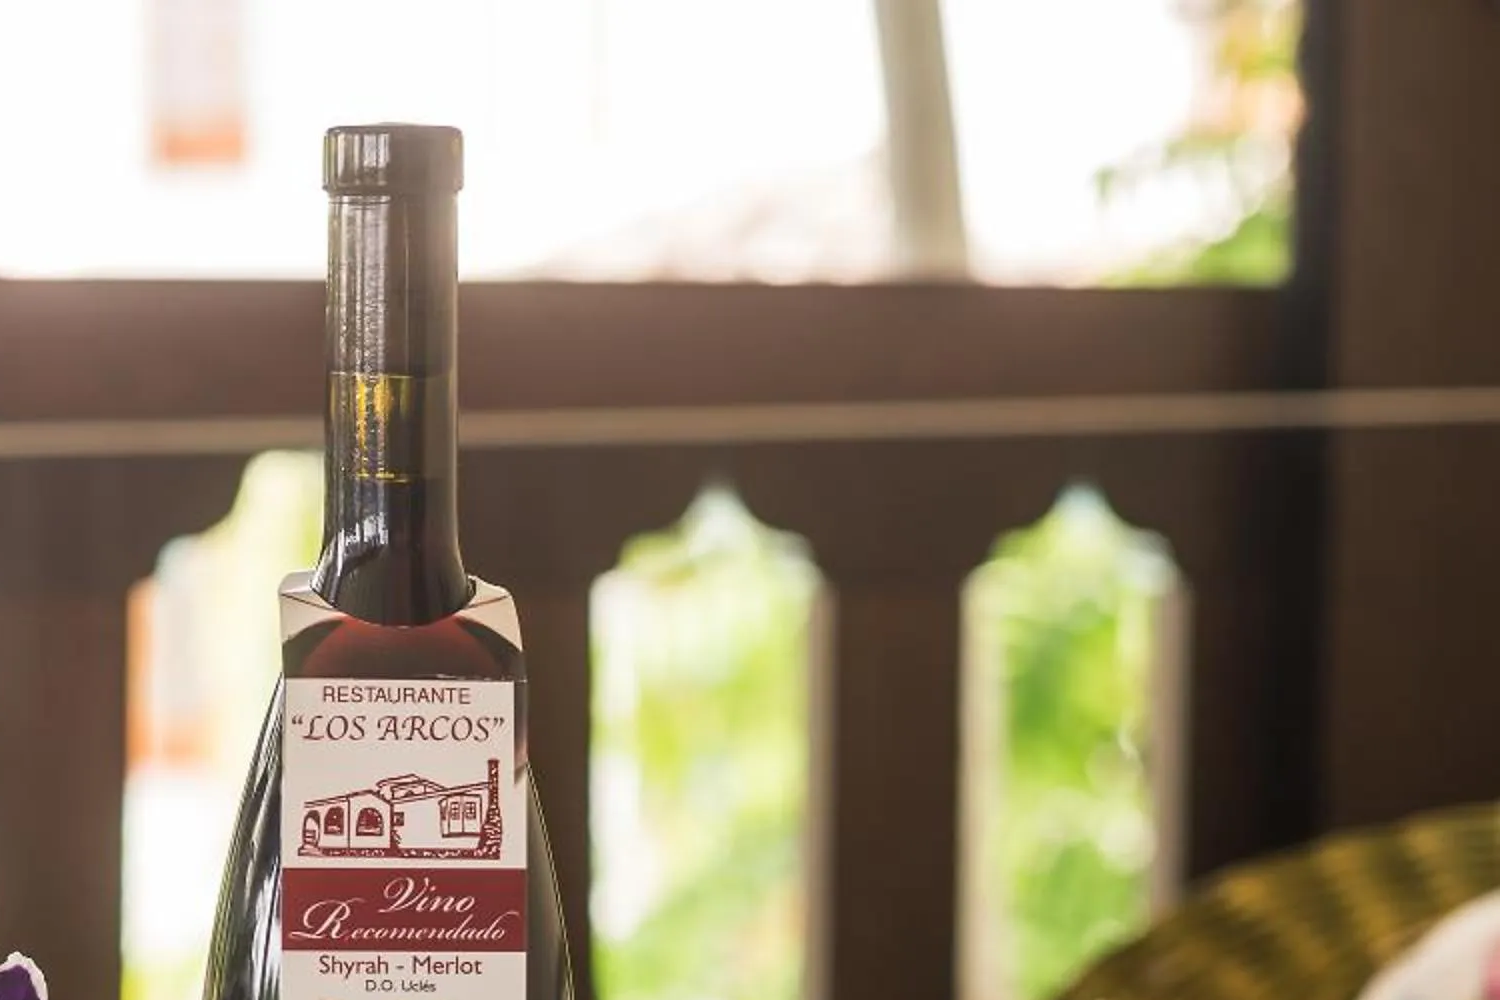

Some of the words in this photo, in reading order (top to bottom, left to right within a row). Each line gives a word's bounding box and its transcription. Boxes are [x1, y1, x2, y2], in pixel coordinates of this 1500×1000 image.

[323, 685, 471, 704] RESTAURANTE
[378, 876, 475, 914] Vino
[291, 897, 520, 941] Recomendado
[318, 955, 389, 979] Shyrah
[412, 956, 483, 975] Merlot
[364, 980, 398, 992] D.O.
[401, 980, 437, 992] Uclés
